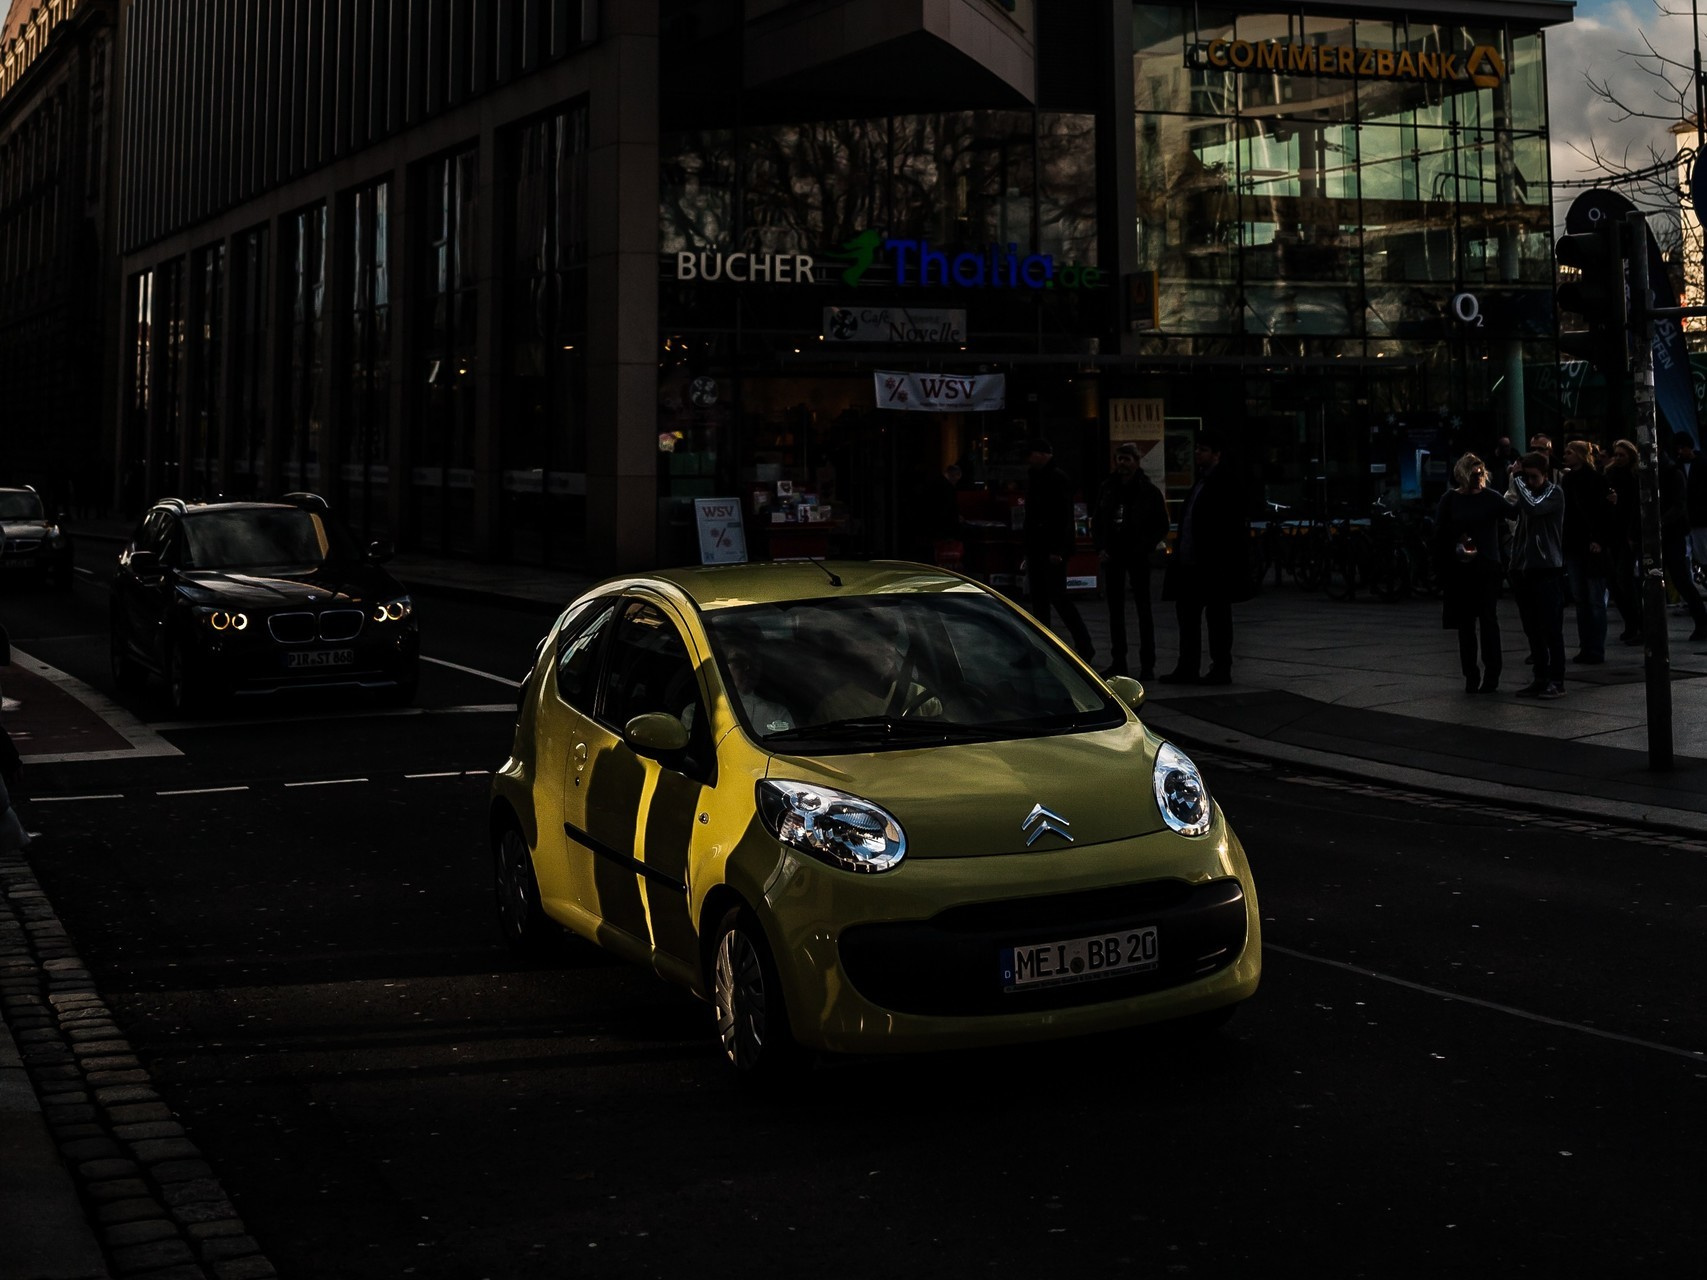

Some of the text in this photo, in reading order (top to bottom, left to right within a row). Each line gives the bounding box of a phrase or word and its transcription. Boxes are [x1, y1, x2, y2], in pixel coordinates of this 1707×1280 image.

[1207, 38, 1457, 81] COMMERZBANK
[676, 244, 816, 284] BÜCHER
[889, 322, 961, 343] Novelle
[919, 377, 976, 400] WSV
[703, 506, 735, 518] WSV
[317, 652, 330, 665] ST
[1004, 931, 1157, 981] D MEI BB 20
